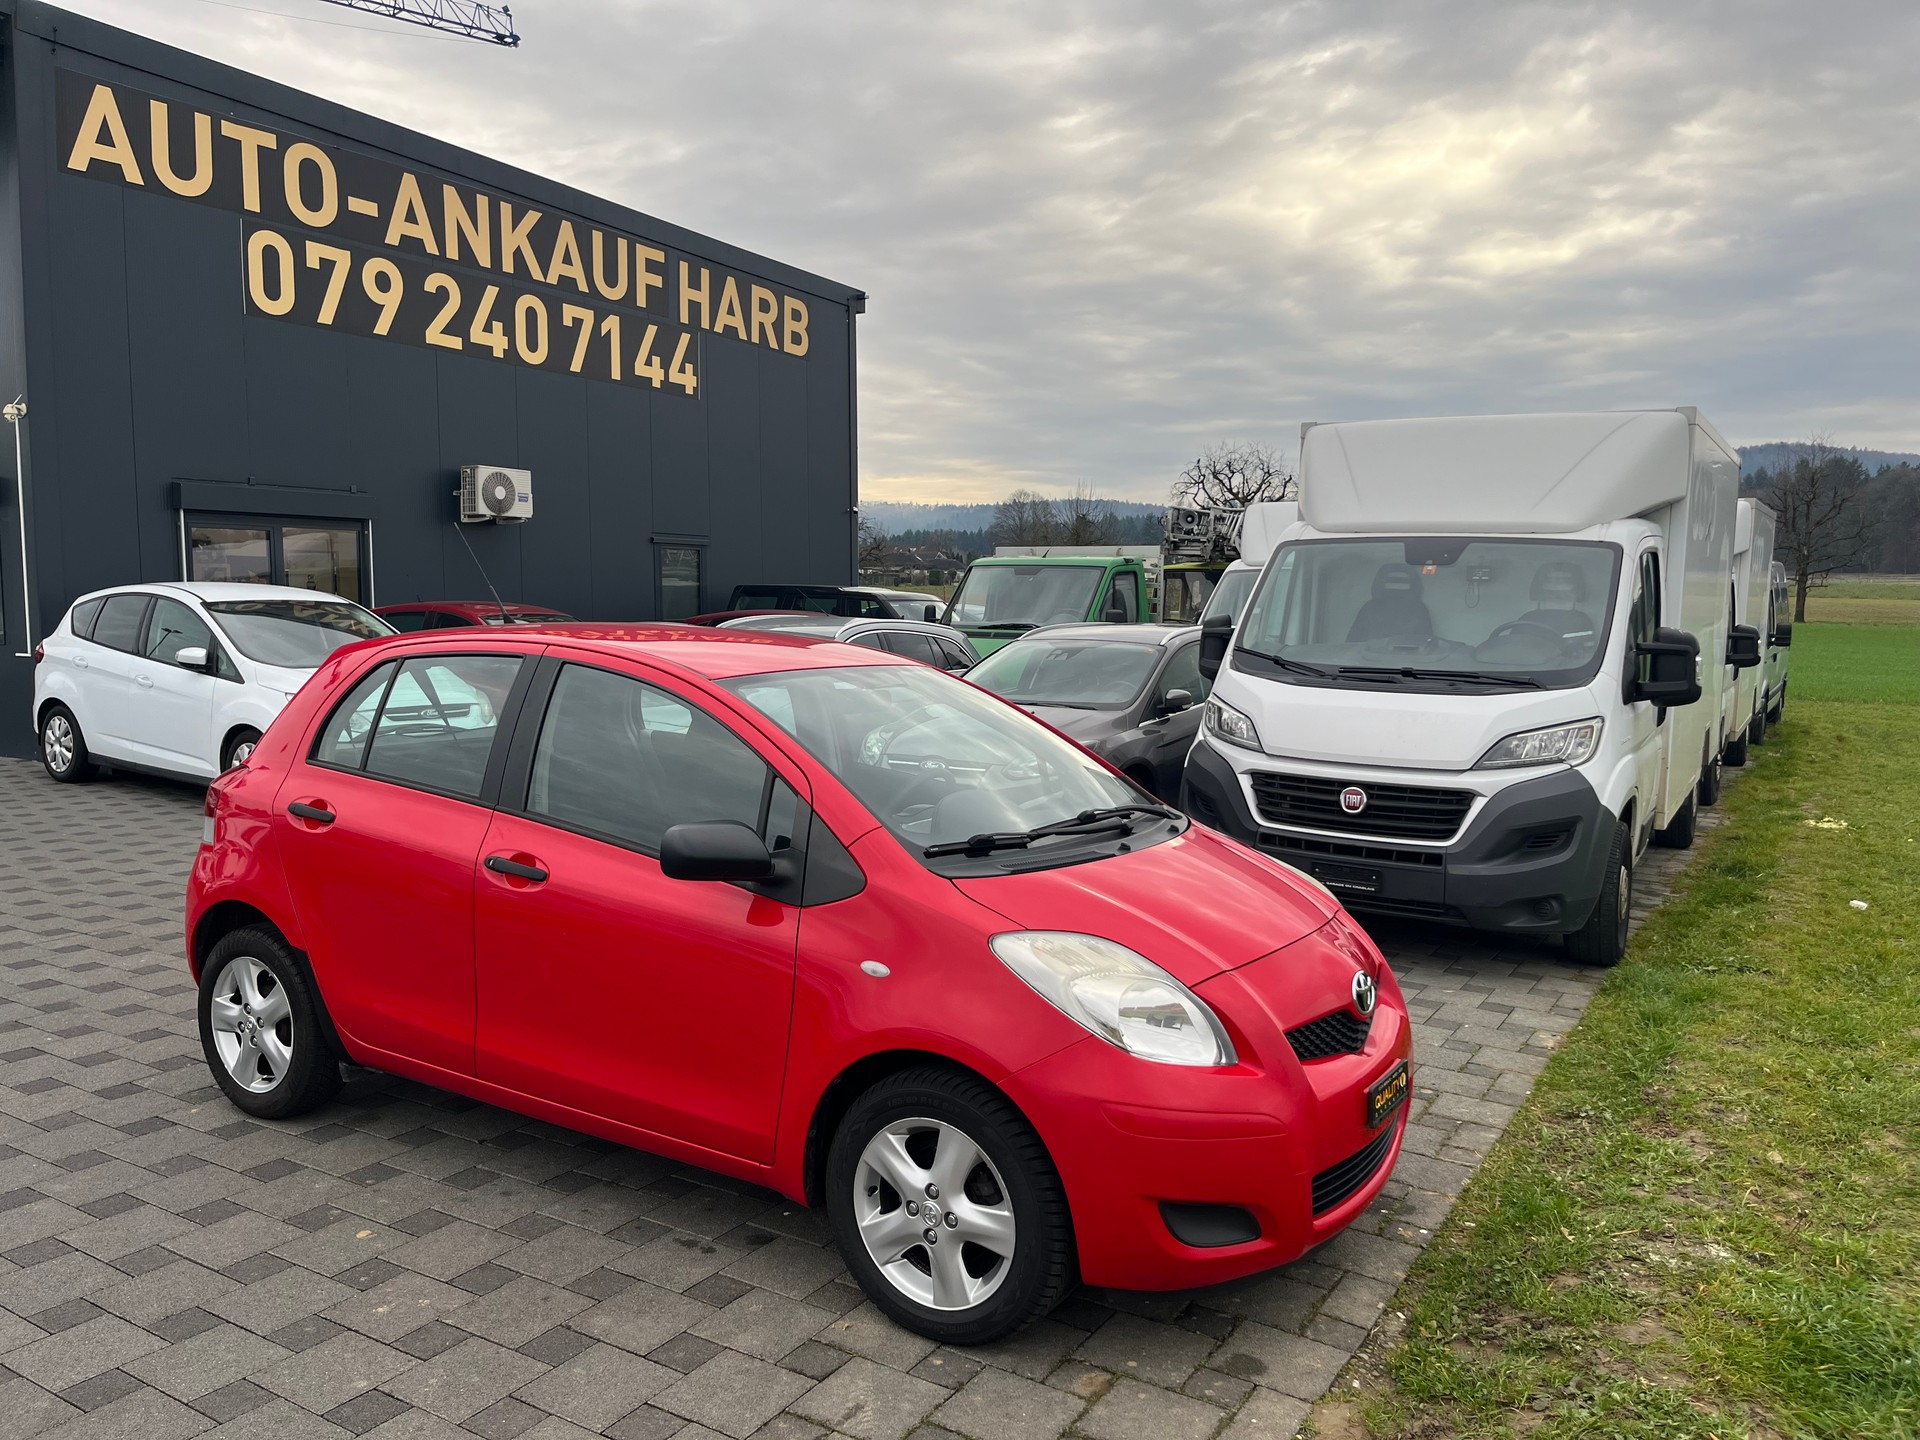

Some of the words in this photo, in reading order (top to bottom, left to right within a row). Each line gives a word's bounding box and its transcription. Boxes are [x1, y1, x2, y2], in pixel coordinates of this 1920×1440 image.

[67, 84, 666, 308] AUTO-ANKAUF
[679, 258, 810, 358] HARB
[247, 230, 404, 336] 079
[423, 272, 549, 365] 240
[1345, 795, 1361, 806] FIAT
